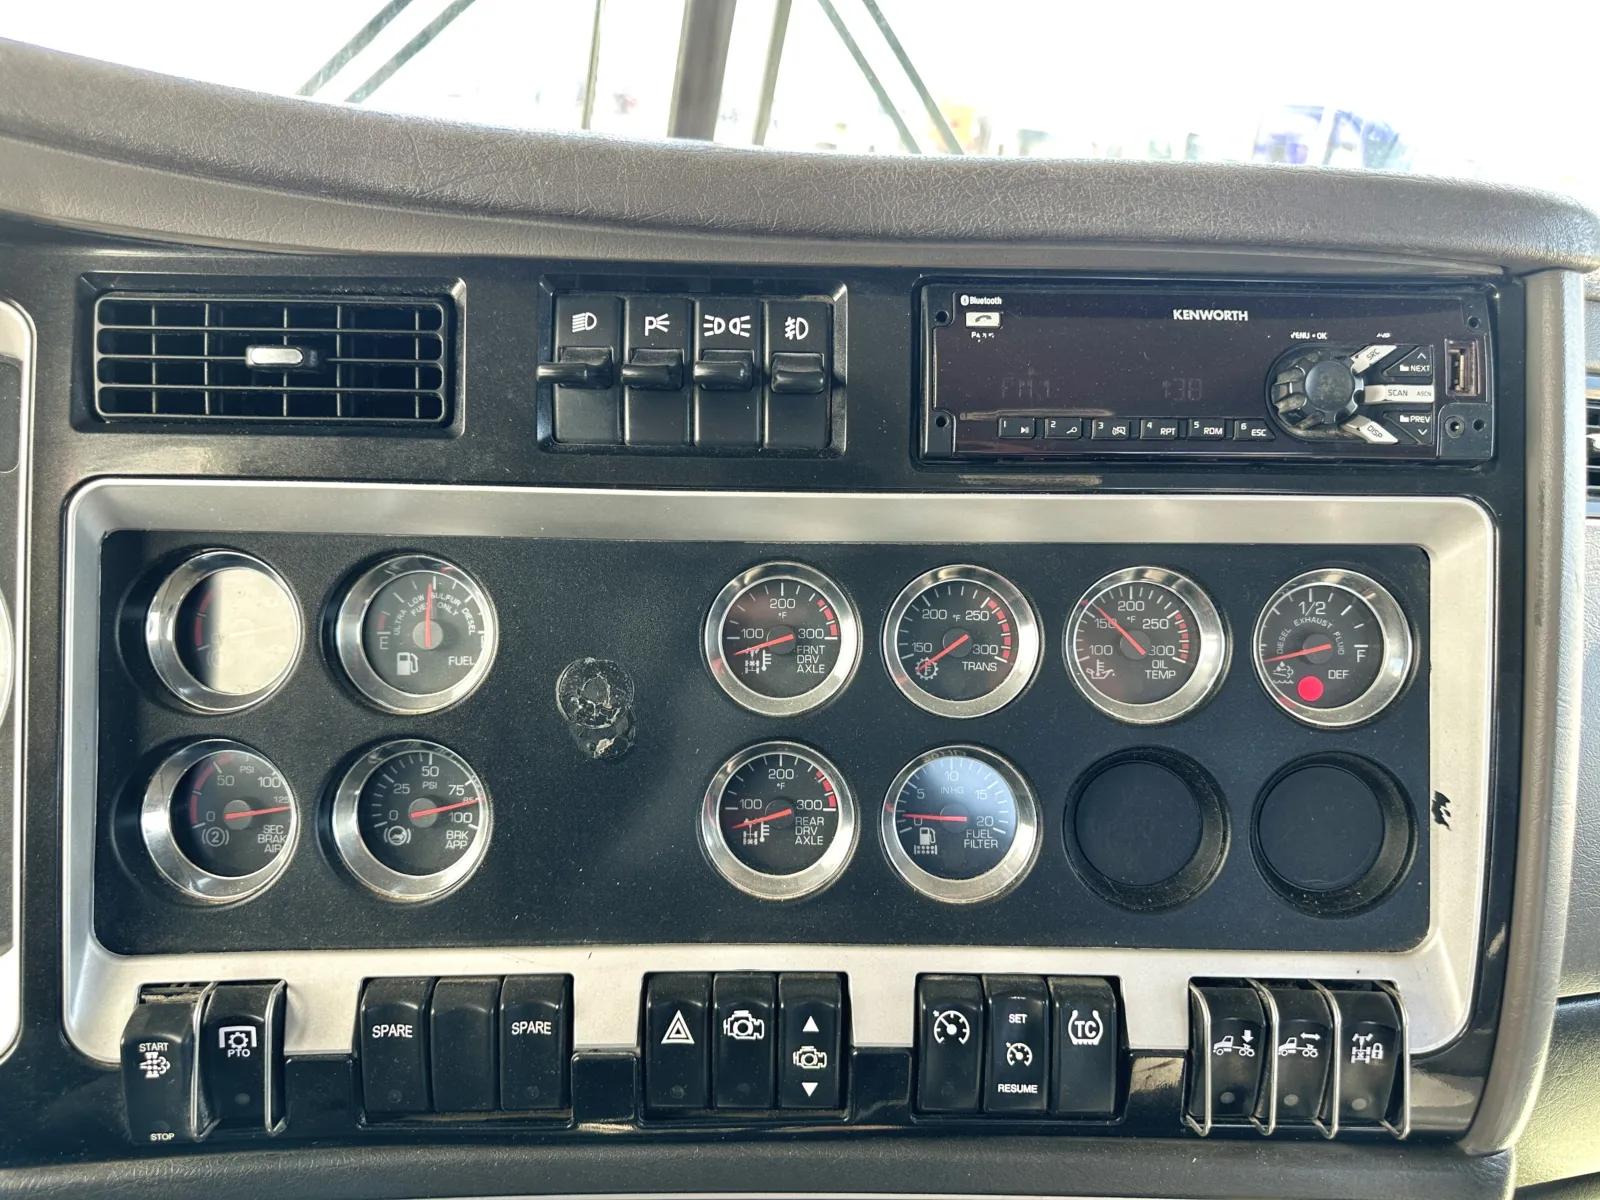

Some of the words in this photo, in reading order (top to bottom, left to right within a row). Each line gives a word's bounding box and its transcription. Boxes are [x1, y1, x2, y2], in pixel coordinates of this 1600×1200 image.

[969, 296, 1002, 305] Bluetooth
[1173, 309, 1248, 321] KENWORTH
[1316, 332, 1328, 340] OK
[1366, 349, 1381, 361] SRC
[1387, 389, 1408, 397] SCAN
[1410, 415, 1431, 423] PREV
[1098, 421, 1104, 429] 3
[1147, 421, 1153, 429] 4
[1194, 421, 1200, 429] 5
[1160, 428, 1176, 436] RPT
[1203, 427, 1223, 435] RDM
[1251, 429, 1267, 437] ESC
[1367, 425, 1383, 438] DISP
[437, 602, 459, 616] ONLY
[769, 598, 796, 609] 200
[1117, 600, 1145, 612] 200
[1298, 601, 1326, 616] 1/2
[393, 609, 408, 635] ULTRA
[407, 593, 425, 607] LOW
[430, 592, 461, 606] SULFUR
[922, 609, 948, 620] 200
[965, 610, 990, 621] 250
[1095, 618, 1117, 629] 150
[1142, 619, 1169, 630] 250
[741, 628, 764, 639] 100
[798, 629, 824, 639] 300
[1276, 628, 1293, 655] DIESEL
[1293, 617, 1333, 629] EXHAUST
[1333, 631, 1345, 656] FLUID
[380, 636, 389, 650] E
[912, 642, 933, 653] 150
[796, 645, 826, 654] FRNT
[972, 644, 999, 655] 300
[1089, 645, 1113, 656] 100
[1148, 645, 1175, 656] 300
[448, 656, 475, 666] FUEL
[797, 655, 820, 664] DRV
[1356, 649, 1366, 663] F
[796, 665, 825, 674] AXLE
[961, 661, 997, 672] TRANS
[1151, 660, 1168, 669] OIL
[1144, 670, 1177, 680] TEMP
[1328, 669, 1350, 680] DEF
[240, 765, 255, 774] PSI
[421, 766, 440, 777] 50
[768, 769, 794, 780] 200
[217, 776, 235, 786] 50
[944, 770, 960, 782] 10
[257, 777, 281, 788] 100
[422, 781, 438, 789] PSI
[393, 783, 411, 794] 25
[448, 785, 465, 796] 75
[917, 788, 925, 800] 5
[975, 789, 988, 800] 15
[740, 799, 762, 810] 100
[796, 800, 823, 811] 300
[206, 811, 216, 822] 0
[389, 810, 399, 821] 0
[449, 812, 472, 823] 100
[795, 816, 825, 826] REAR
[976, 816, 994, 827] 20
[263, 825, 284, 835] SEC
[446, 830, 469, 840] BRK
[795, 826, 818, 836] DRV
[966, 829, 993, 839] FUEL
[211, 831, 220, 843] 2
[257, 834, 288, 844] BRAK
[794, 836, 824, 845] AXLE
[264, 844, 282, 853] AIR
[445, 840, 468, 850] APP
[964, 839, 999, 849] FILTER
[1008, 1013, 1028, 1024] SET
[372, 1024, 413, 1038] SPARE
[511, 1021, 552, 1035] SPARE
[1074, 1021, 1097, 1038] TC
[139, 1042, 169, 1052] START
[227, 1049, 251, 1058] PTO
[998, 1084, 1038, 1094] RESUME
[150, 1133, 175, 1141] STOP
